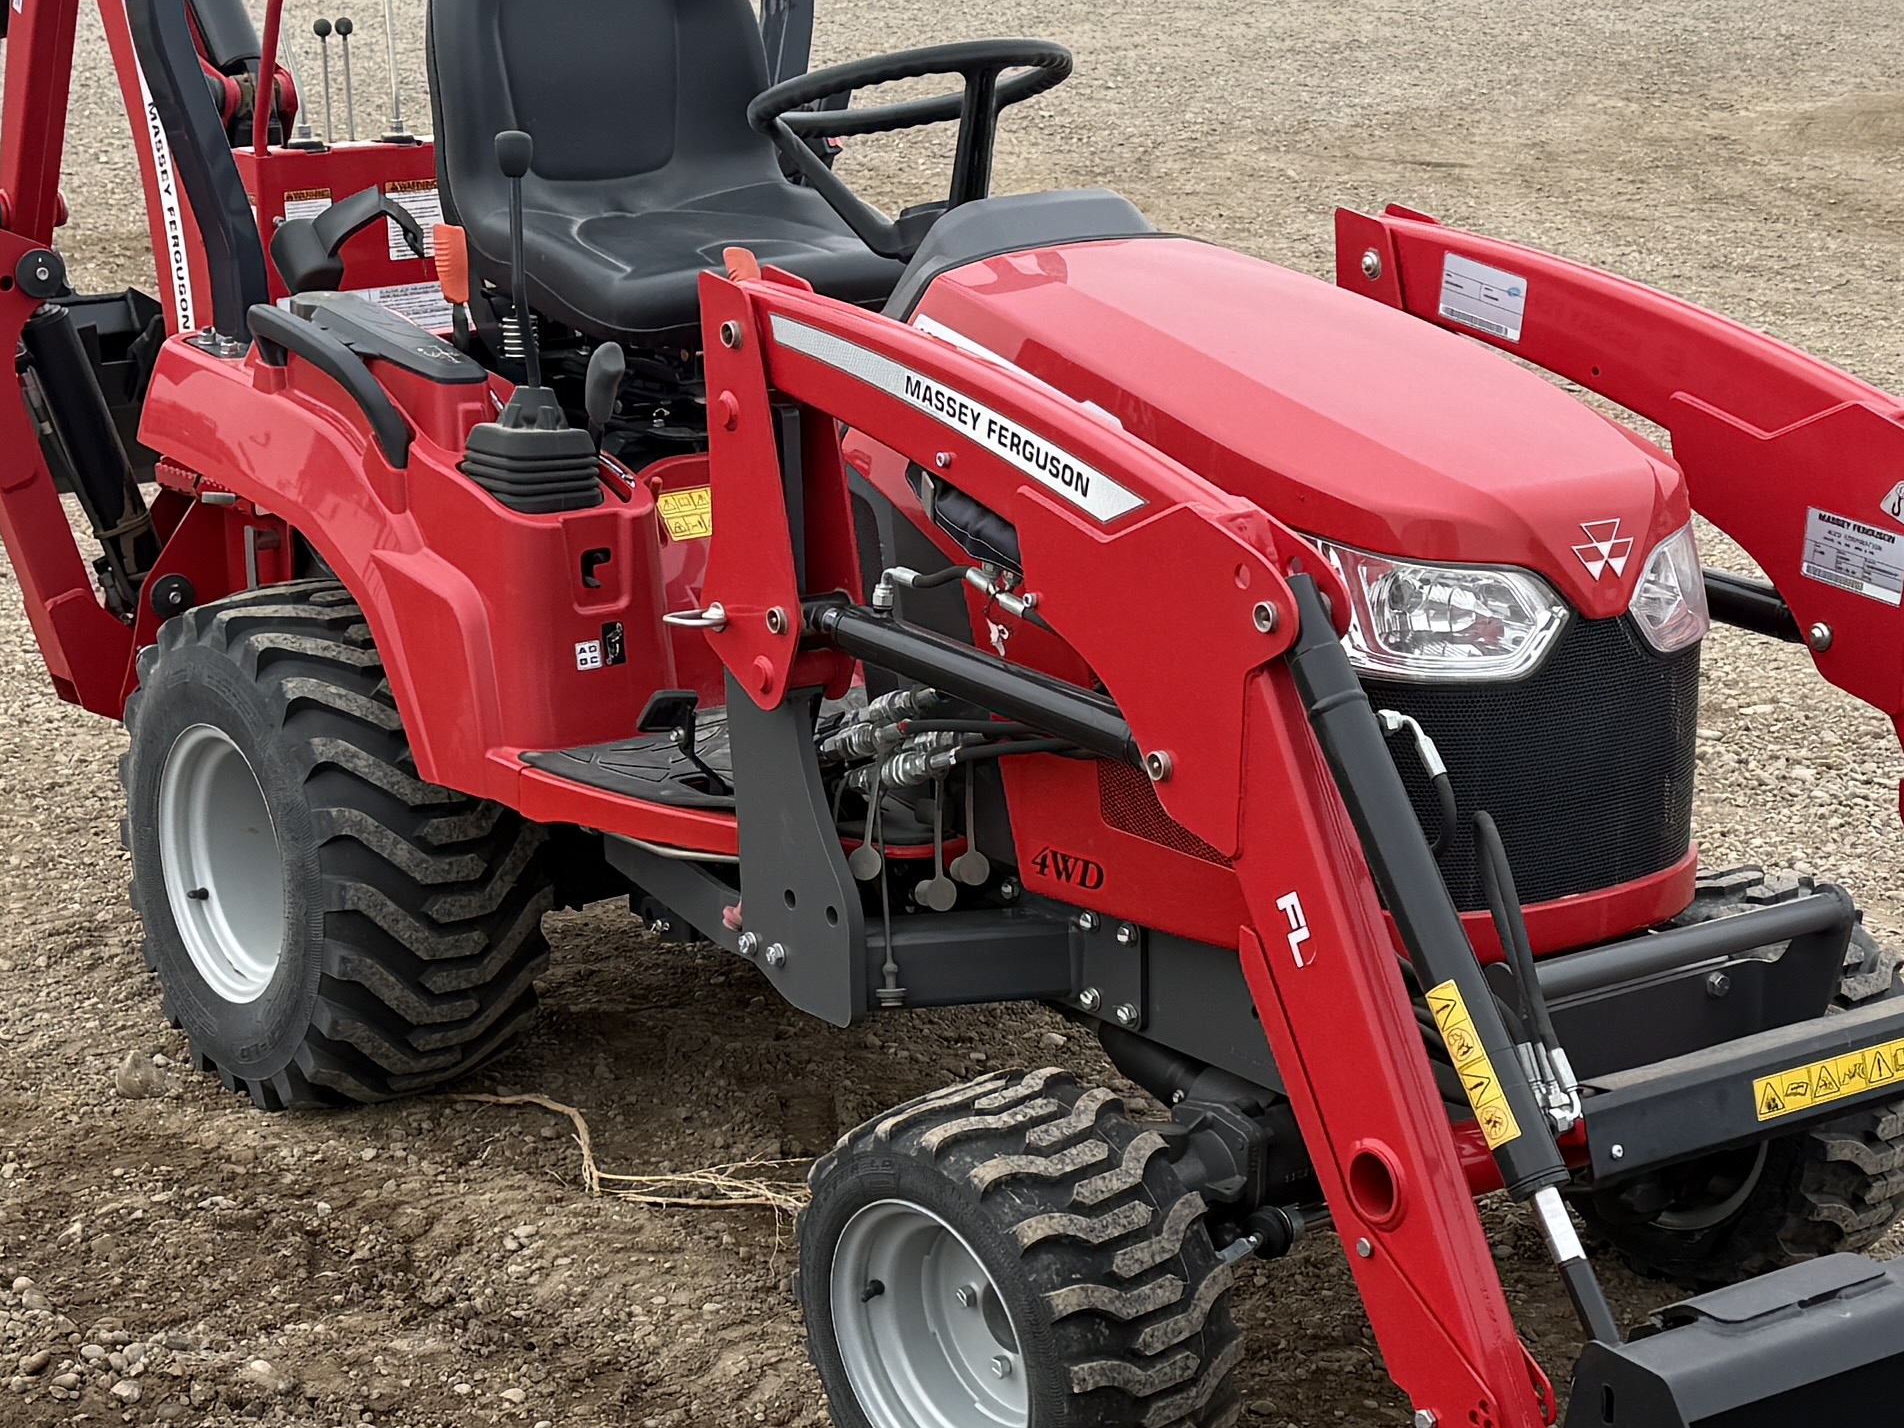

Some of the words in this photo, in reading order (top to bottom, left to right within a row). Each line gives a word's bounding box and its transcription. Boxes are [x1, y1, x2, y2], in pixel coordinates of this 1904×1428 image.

[148, 101, 172, 197] MASSEY
[167, 205, 190, 331] FERGUSON
[905, 376, 981, 431] MASSEY
[987, 419, 1090, 498] FERGUSON
[1818, 512, 1851, 530] MASSEY
[1031, 846, 1104, 890] 4WD
[1276, 891, 1311, 968] FL
